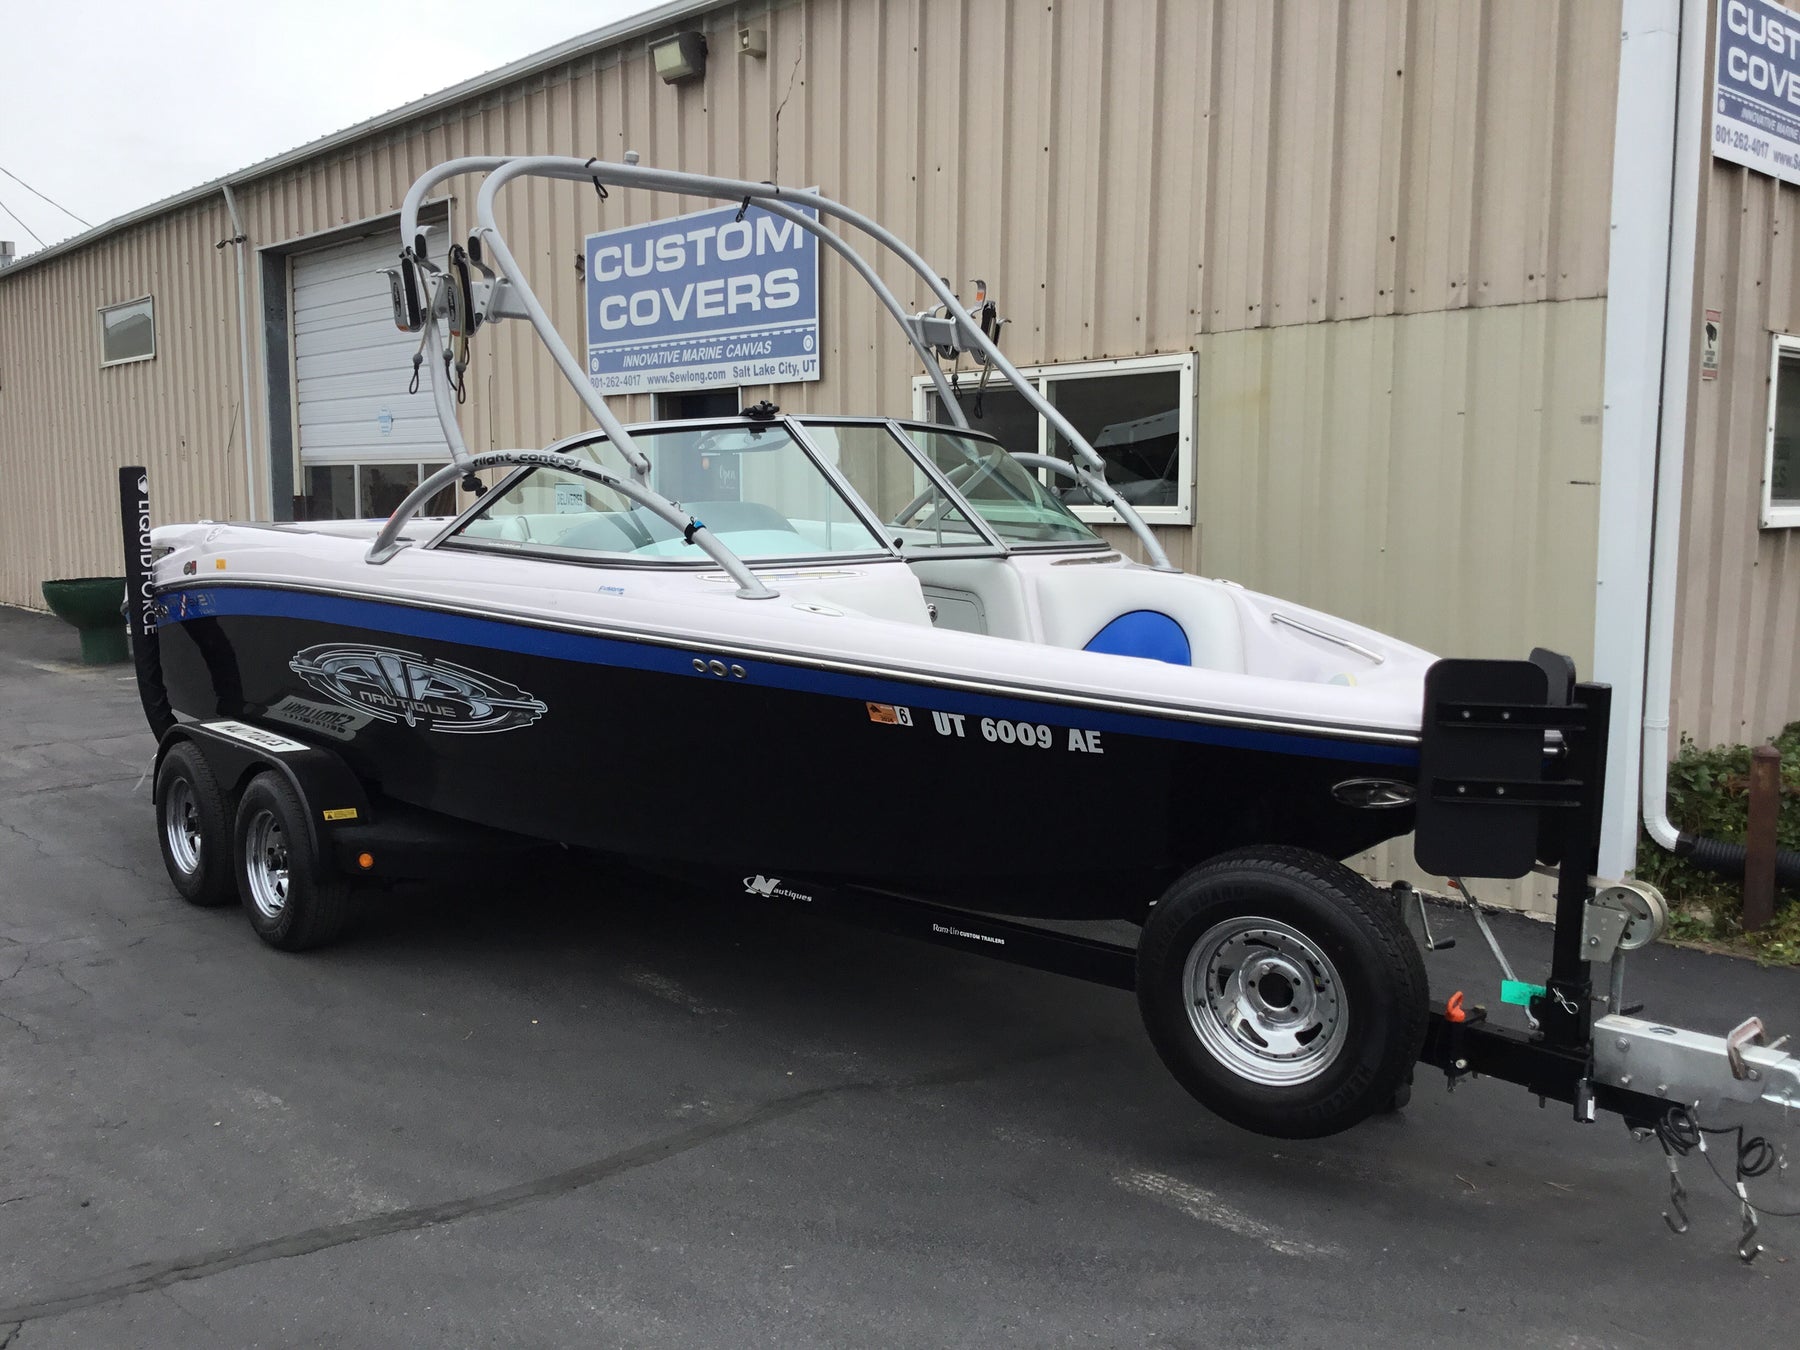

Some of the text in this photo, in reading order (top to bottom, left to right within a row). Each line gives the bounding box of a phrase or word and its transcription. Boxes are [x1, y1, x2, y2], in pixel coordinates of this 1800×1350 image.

[1715, 125, 1769, 159] 801-262-4017
[594, 210, 803, 282] CUSTOM
[600, 268, 800, 331] COVERS
[623, 340, 772, 368] INNOVATIVE MARINE CANVAS
[590, 359, 817, 389] 801-262-4017 www.Sewlong.com Salt Lake City, UT
[472, 453, 581, 467] flight control
[138, 500, 158, 636] LIQUID FORCE
[359, 691, 457, 718] NAUTIQUE
[899, 708, 908, 724] 6
[932, 711, 1104, 753] UT 6009 AE
[743, 875, 813, 902] Nautiques
[960, 931, 981, 940] CUSTOM
[981, 935, 1005, 945] TRAILERS
